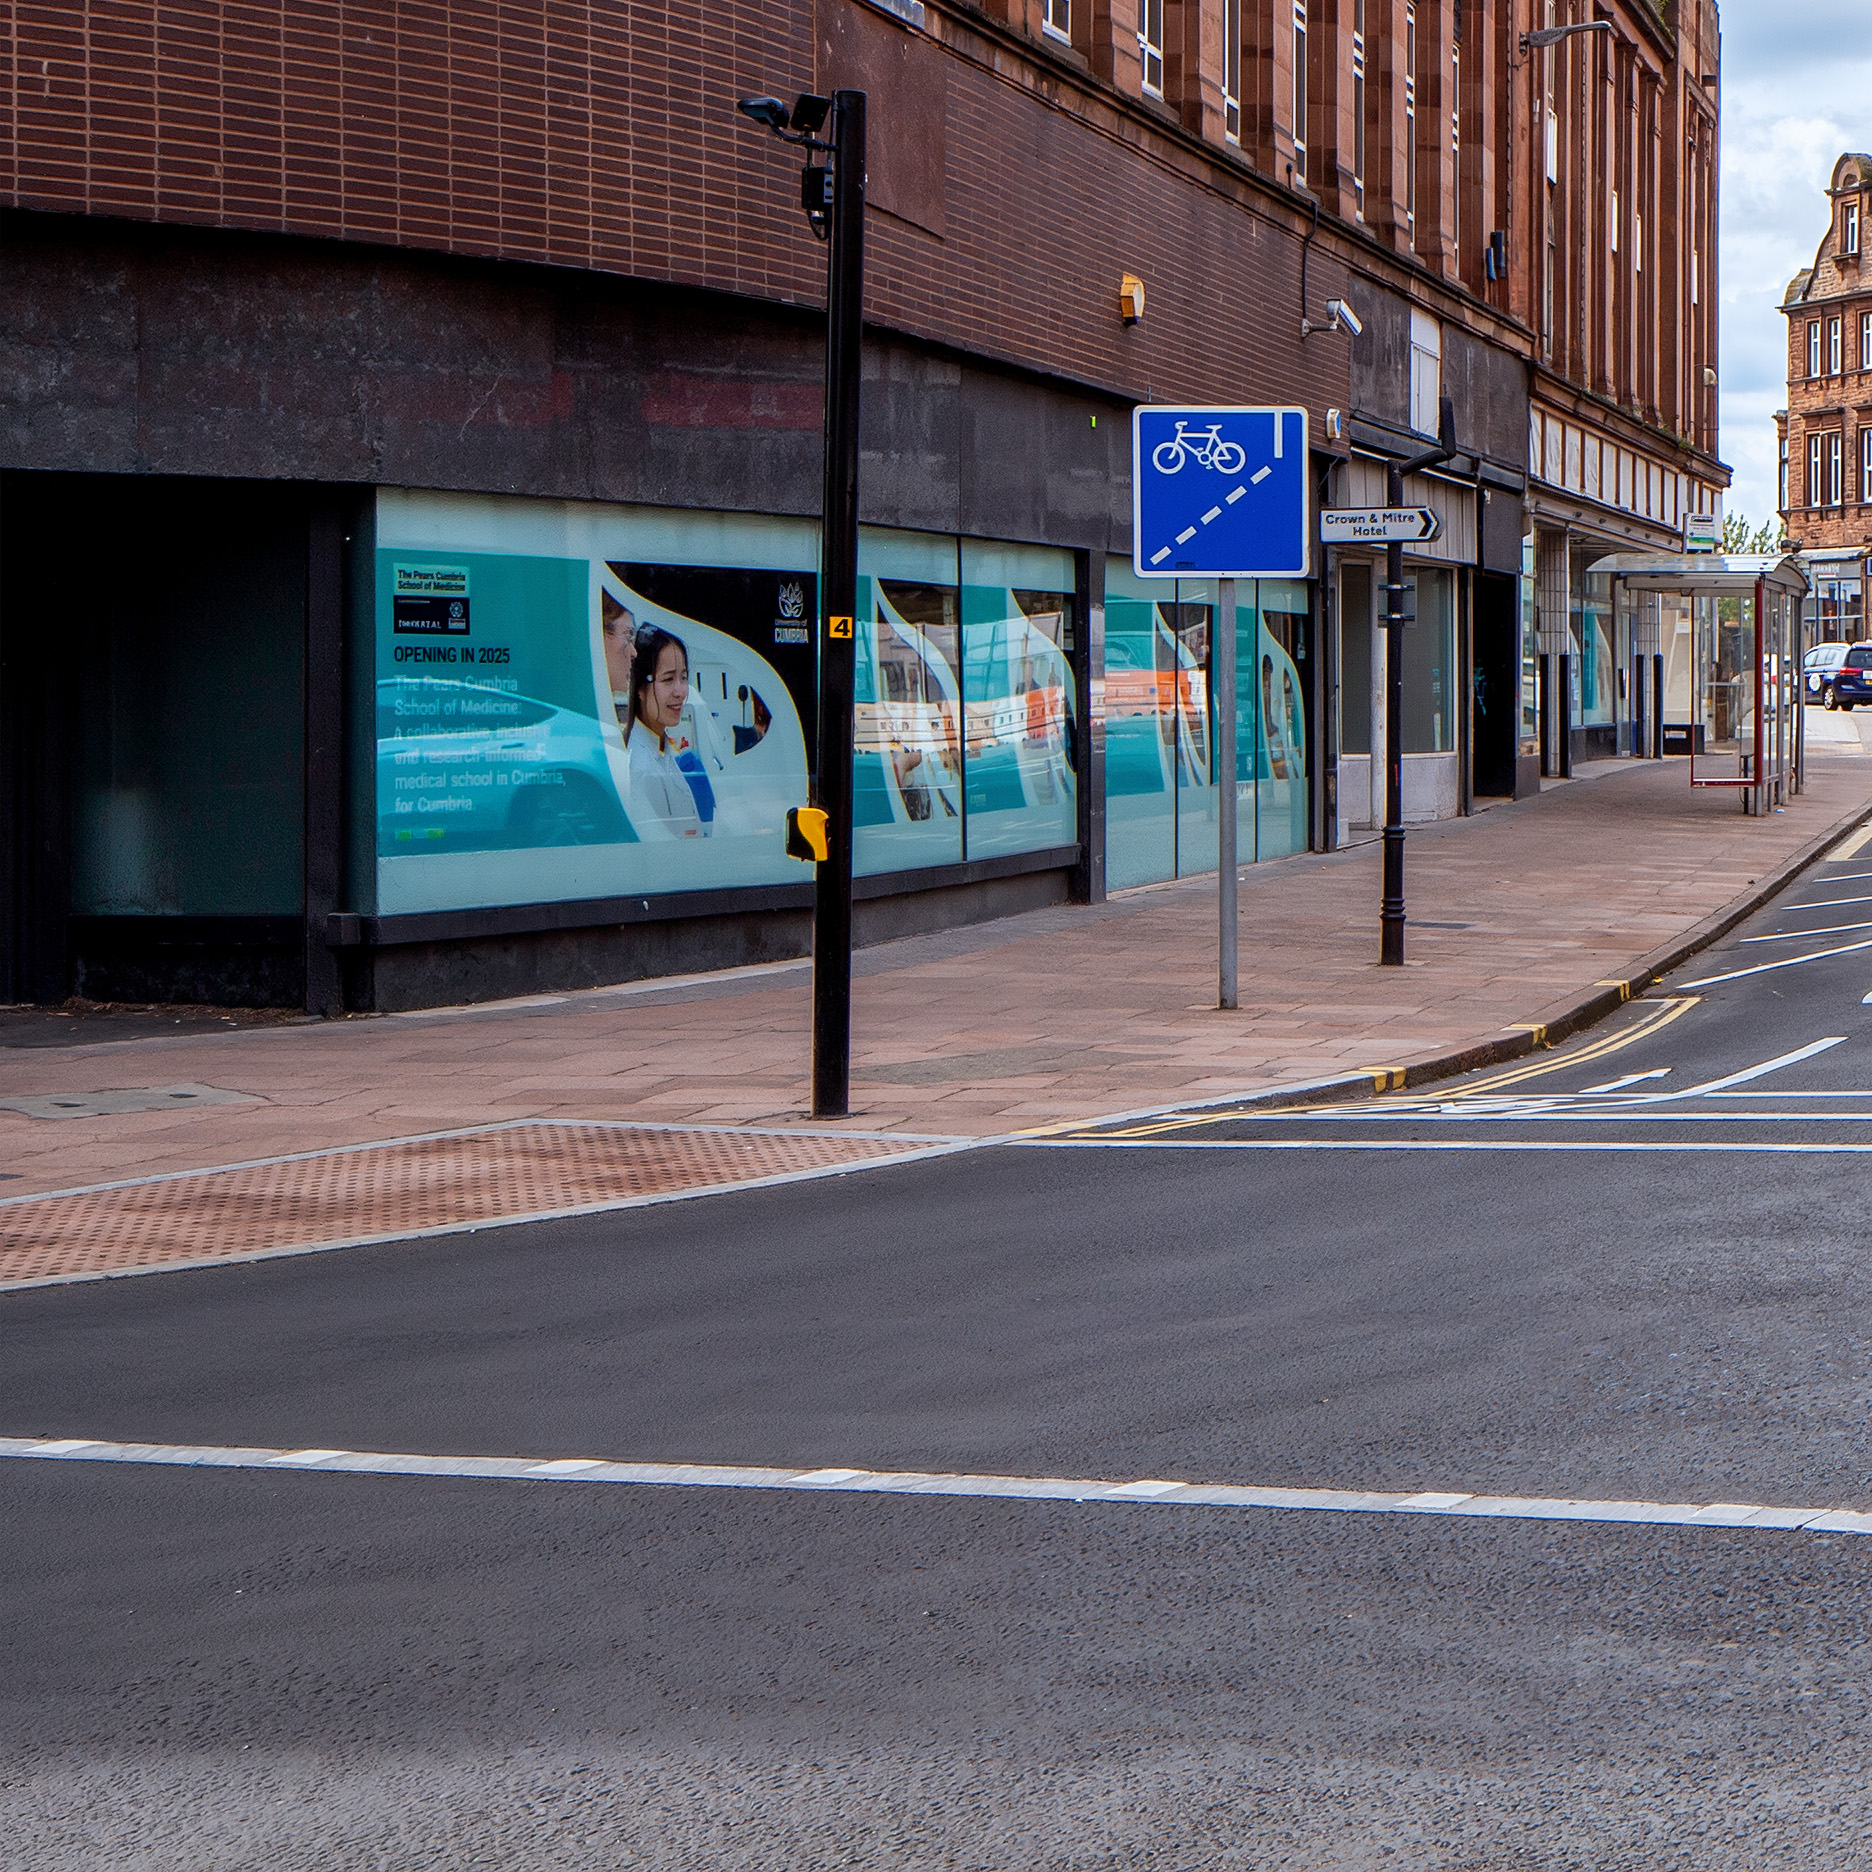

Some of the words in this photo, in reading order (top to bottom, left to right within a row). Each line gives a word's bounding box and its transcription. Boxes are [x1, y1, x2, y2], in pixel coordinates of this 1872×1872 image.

[1325, 515, 1366, 525] Crown
[1369, 513, 1378, 524] &
[1382, 512, 1415, 523] Mitre
[1352, 526, 1388, 536] Hotel
[397, 569, 411, 579] The
[397, 580, 422, 590] School
[423, 581, 432, 590] of
[433, 581, 466, 592] Medicine
[834, 618, 850, 637] 4
[394, 646, 457, 663] OPENING
[461, 647, 475, 663] IN
[478, 647, 510, 664] 2025
[394, 675, 420, 691] The
[465, 675, 518, 692] Cumbria
[395, 699, 440, 715] School
[444, 700, 457, 715] of
[395, 748, 420, 764] and
[395, 772, 446, 790] medical
[451, 771, 493, 787] school
[497, 770, 508, 785] in
[395, 797, 414, 813] for
